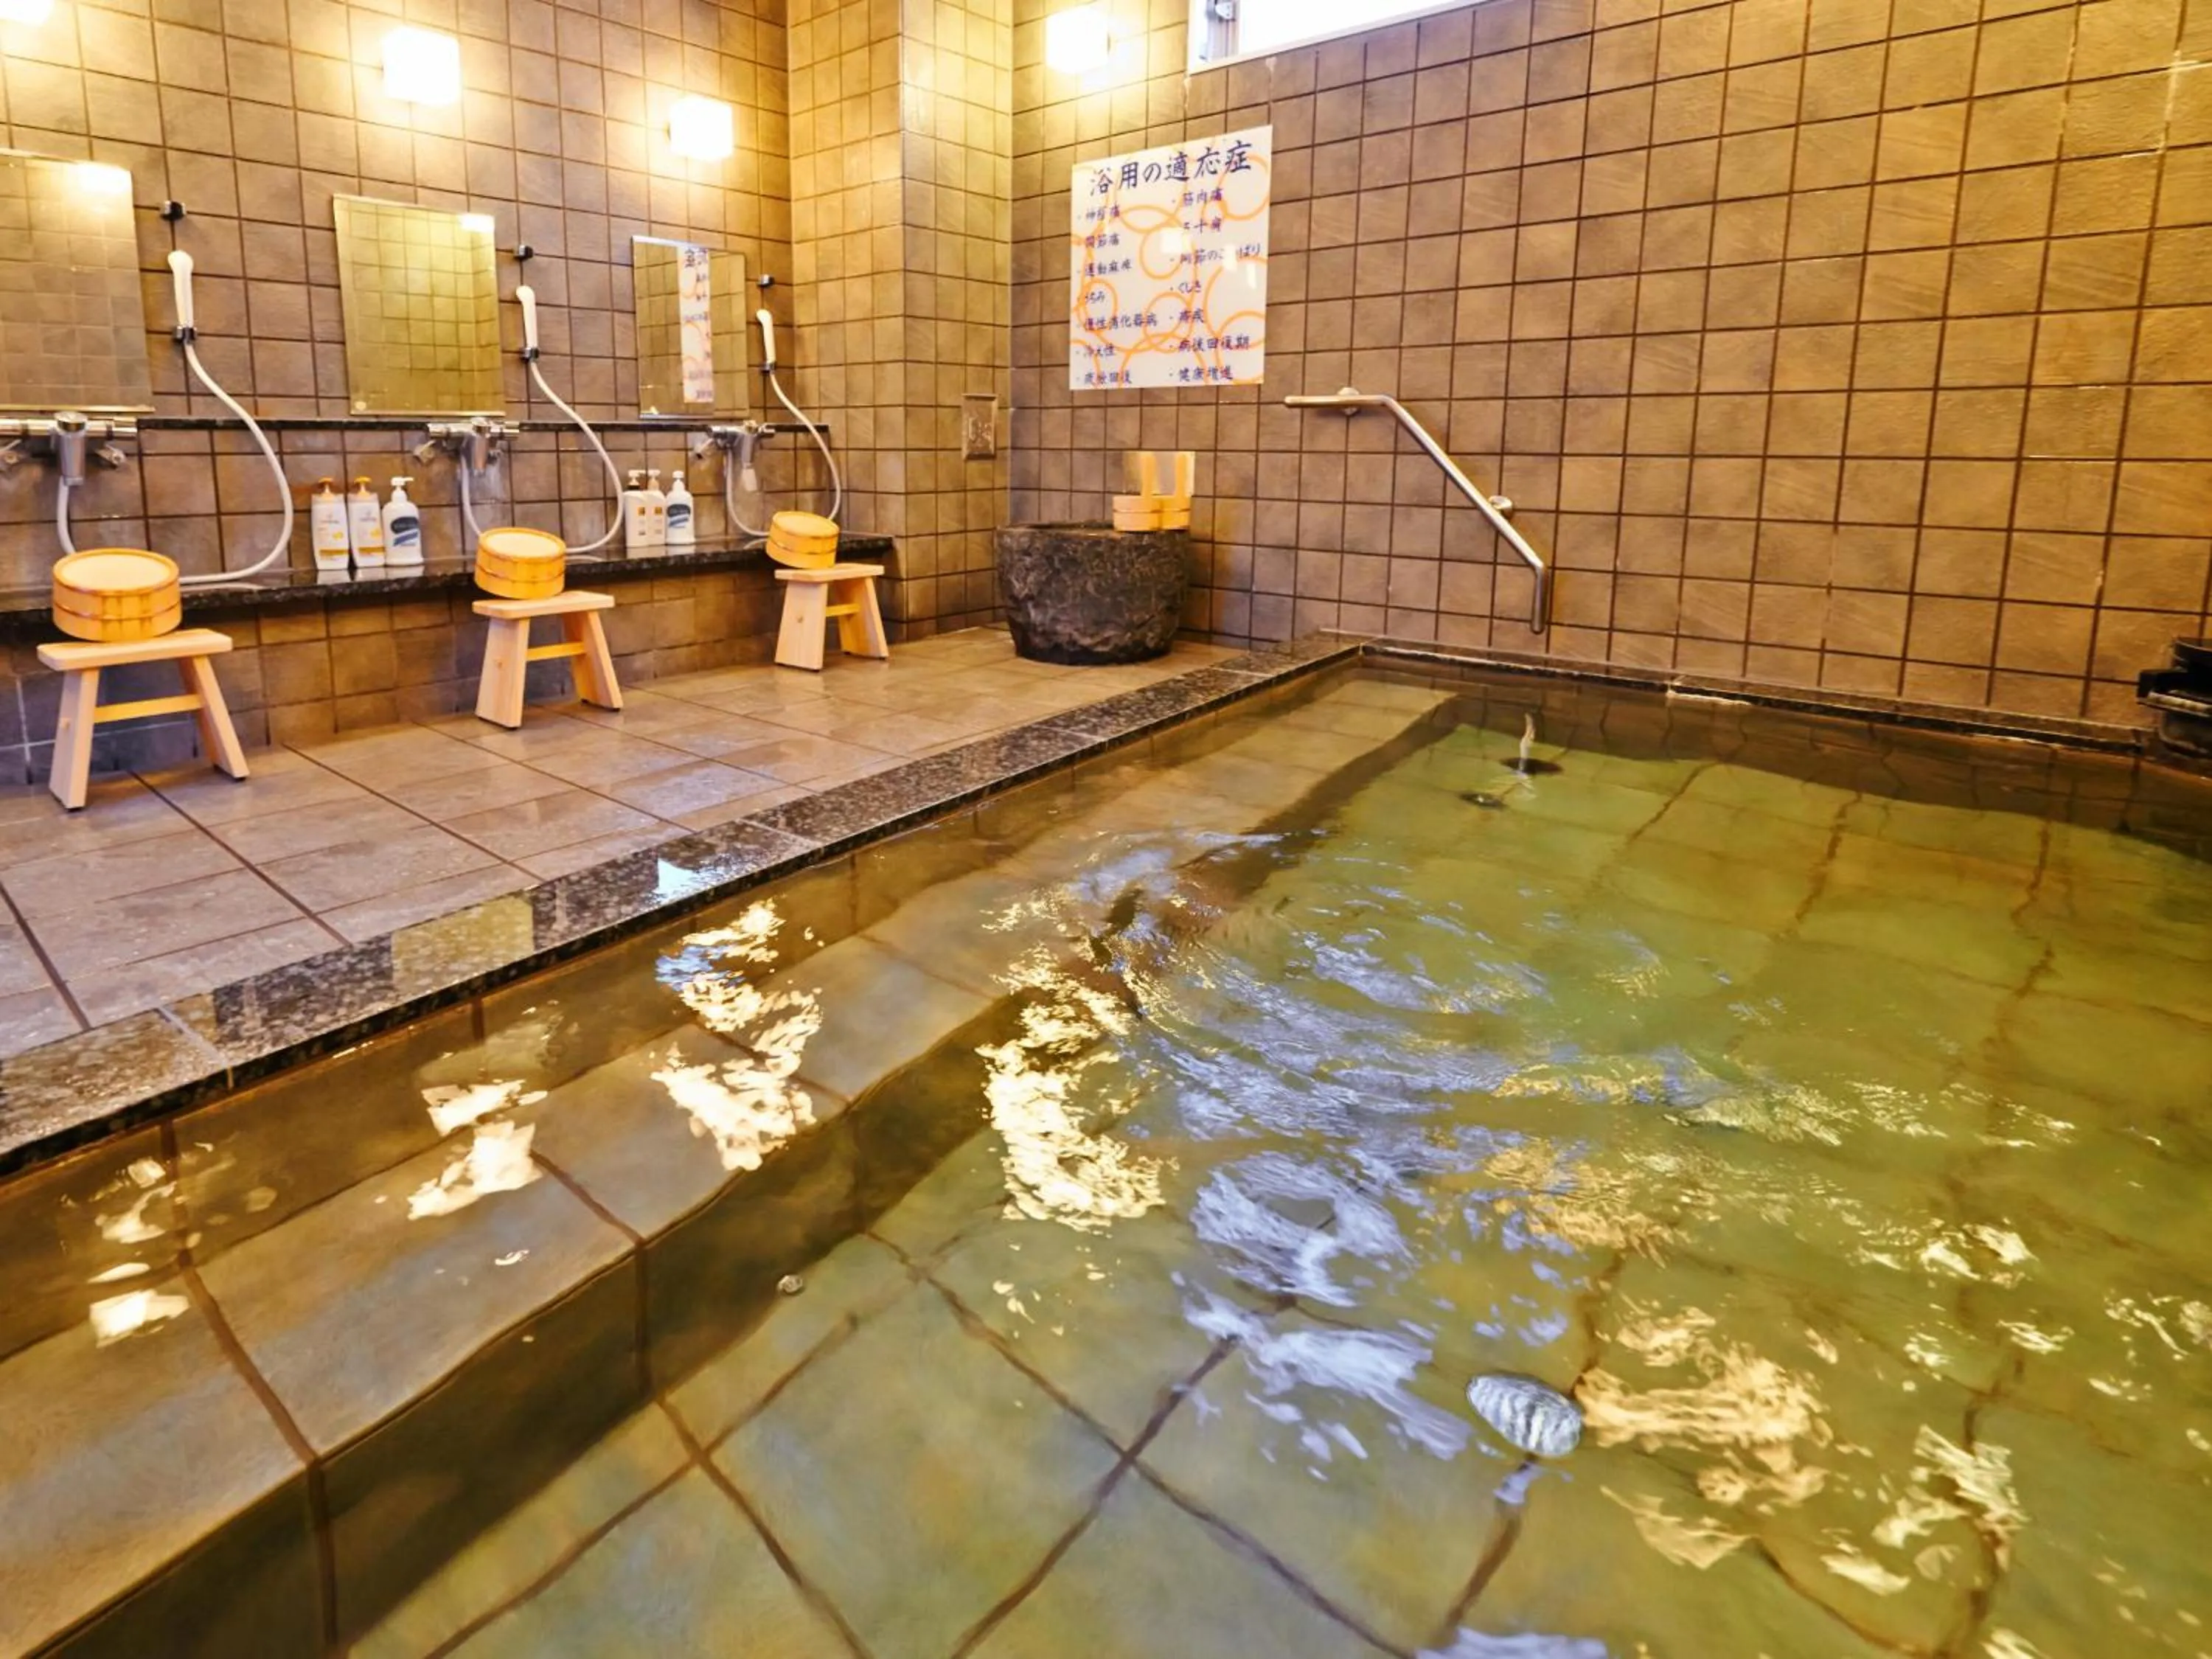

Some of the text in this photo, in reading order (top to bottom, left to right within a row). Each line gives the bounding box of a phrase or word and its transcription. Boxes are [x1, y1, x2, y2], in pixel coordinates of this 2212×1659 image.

[1091, 140, 1251, 196] 浴用の適応症
